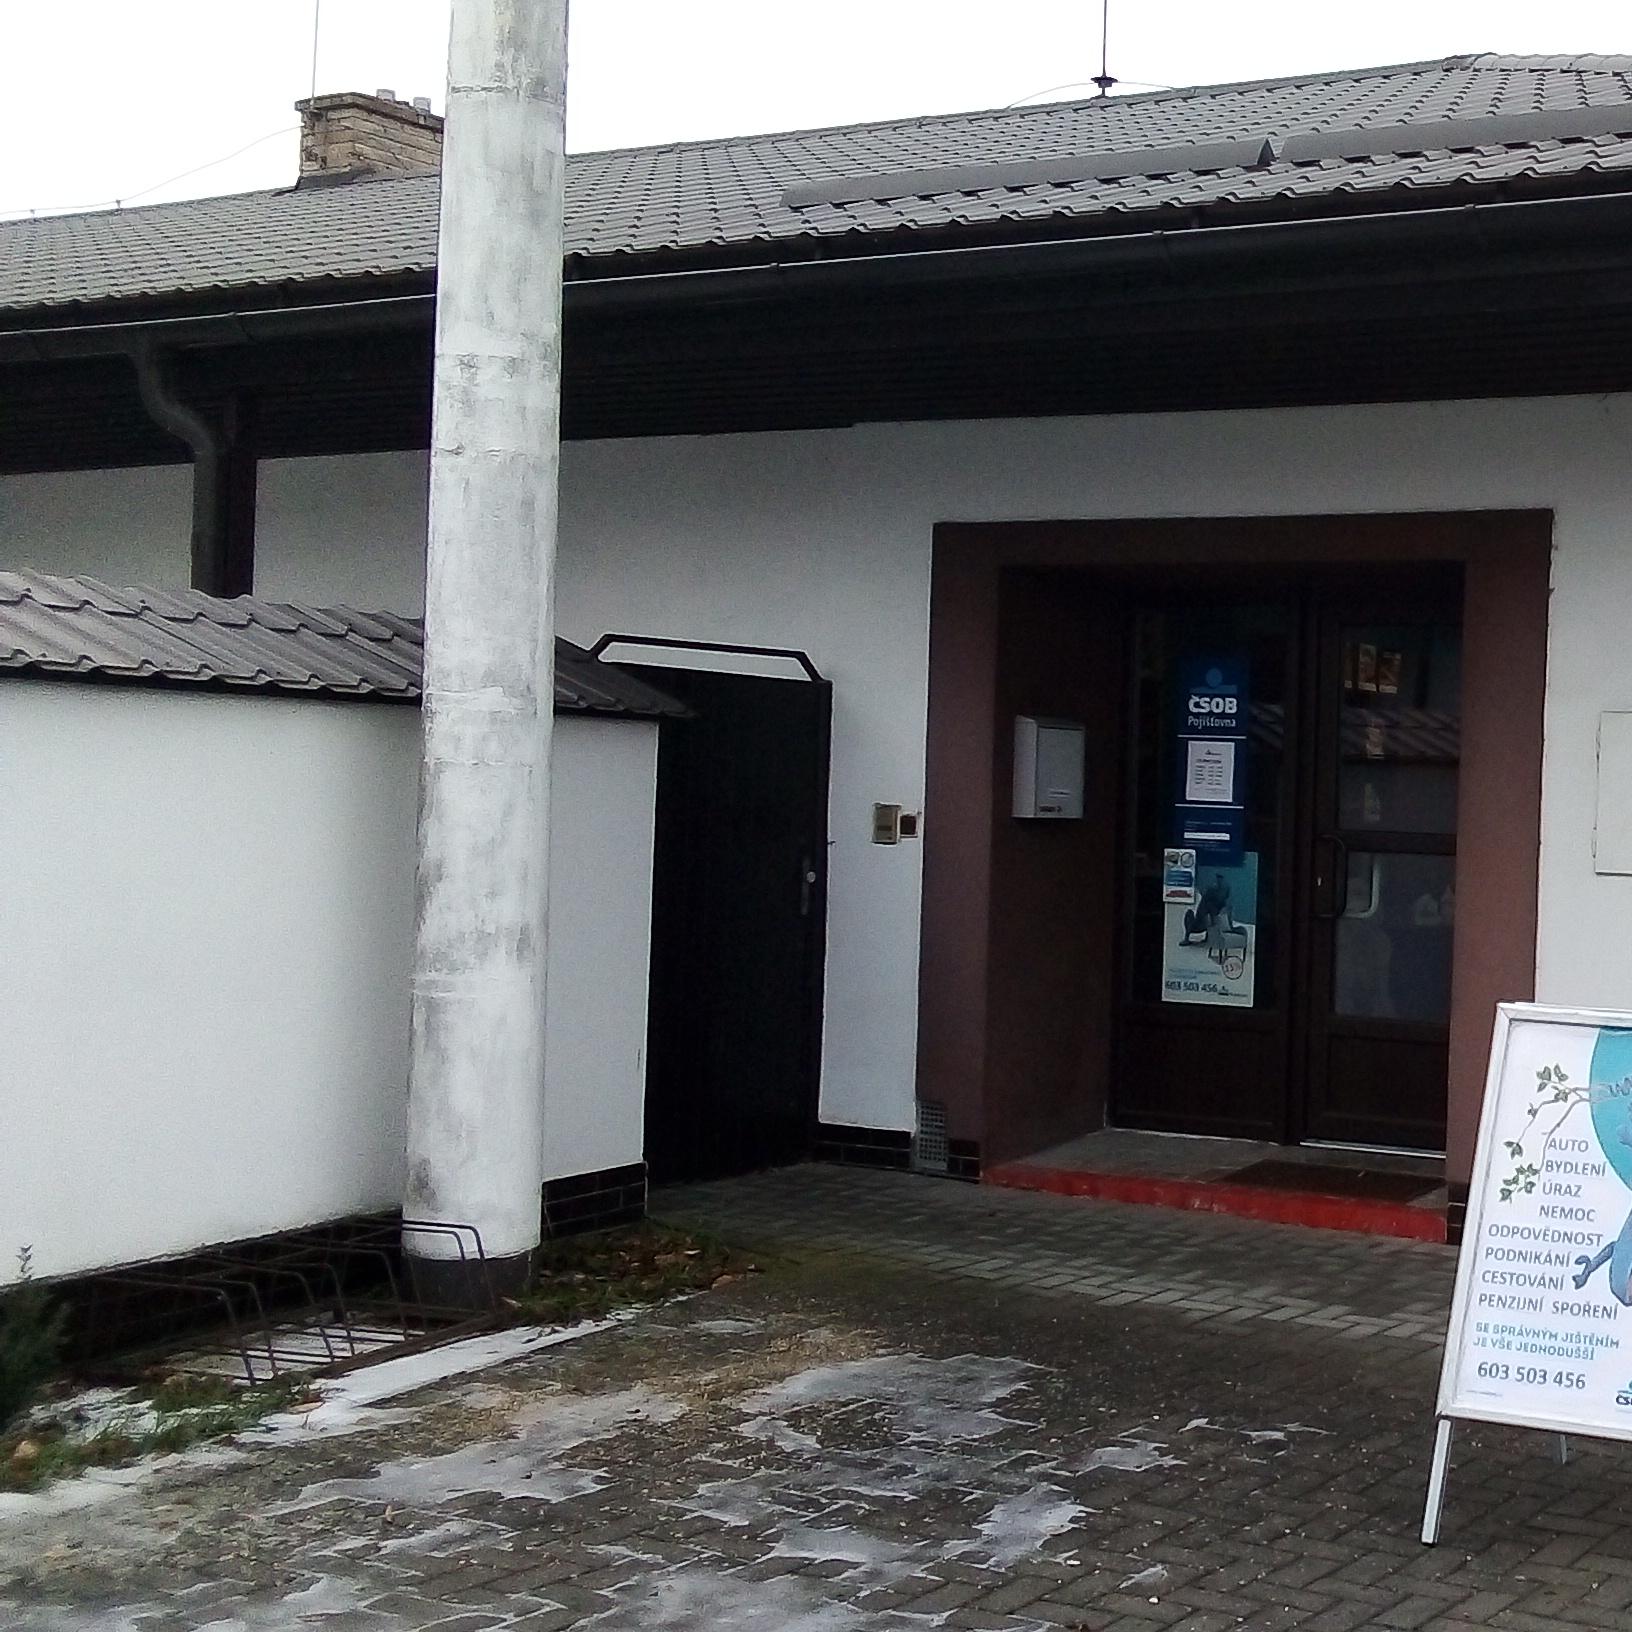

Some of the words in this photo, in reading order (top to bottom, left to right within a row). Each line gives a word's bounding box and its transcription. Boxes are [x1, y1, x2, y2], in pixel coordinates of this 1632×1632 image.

[1188, 695, 1238, 714] ČSOB
[1187, 715, 1236, 729] Pojišťovna
[1548, 1137, 1589, 1152] AUTO
[1545, 1159, 1607, 1176] BYDLENÍ
[1542, 1180, 1582, 1198] ÚRAZ
[1539, 1205, 1596, 1222] NEMOC
[1488, 1224, 1603, 1247] ODPOVĚDNOST
[1485, 1247, 1572, 1267] PODNIKÁNÍ
[1482, 1270, 1565, 1290] CESTOVÁNÍ
[1478, 1293, 1544, 1312] PENZIJNÍ
[1552, 1300, 1618, 1320] SPOŘENÍ
[1476, 1322, 1489, 1333] SE
[1492, 1324, 1558, 1341] SPRÁVNÝM
[1562, 1332, 1620, 1349] JIŠTĚNÍM
[1473, 1337, 1487, 1347] JE
[1490, 1336, 1512, 1350] VŠE
[1516, 1342, 1595, 1360] JEDNODUŠŠÍ
[1477, 1361, 1509, 1380] 603
[1514, 1365, 1547, 1385] 503
[1553, 1370, 1586, 1390] 456
